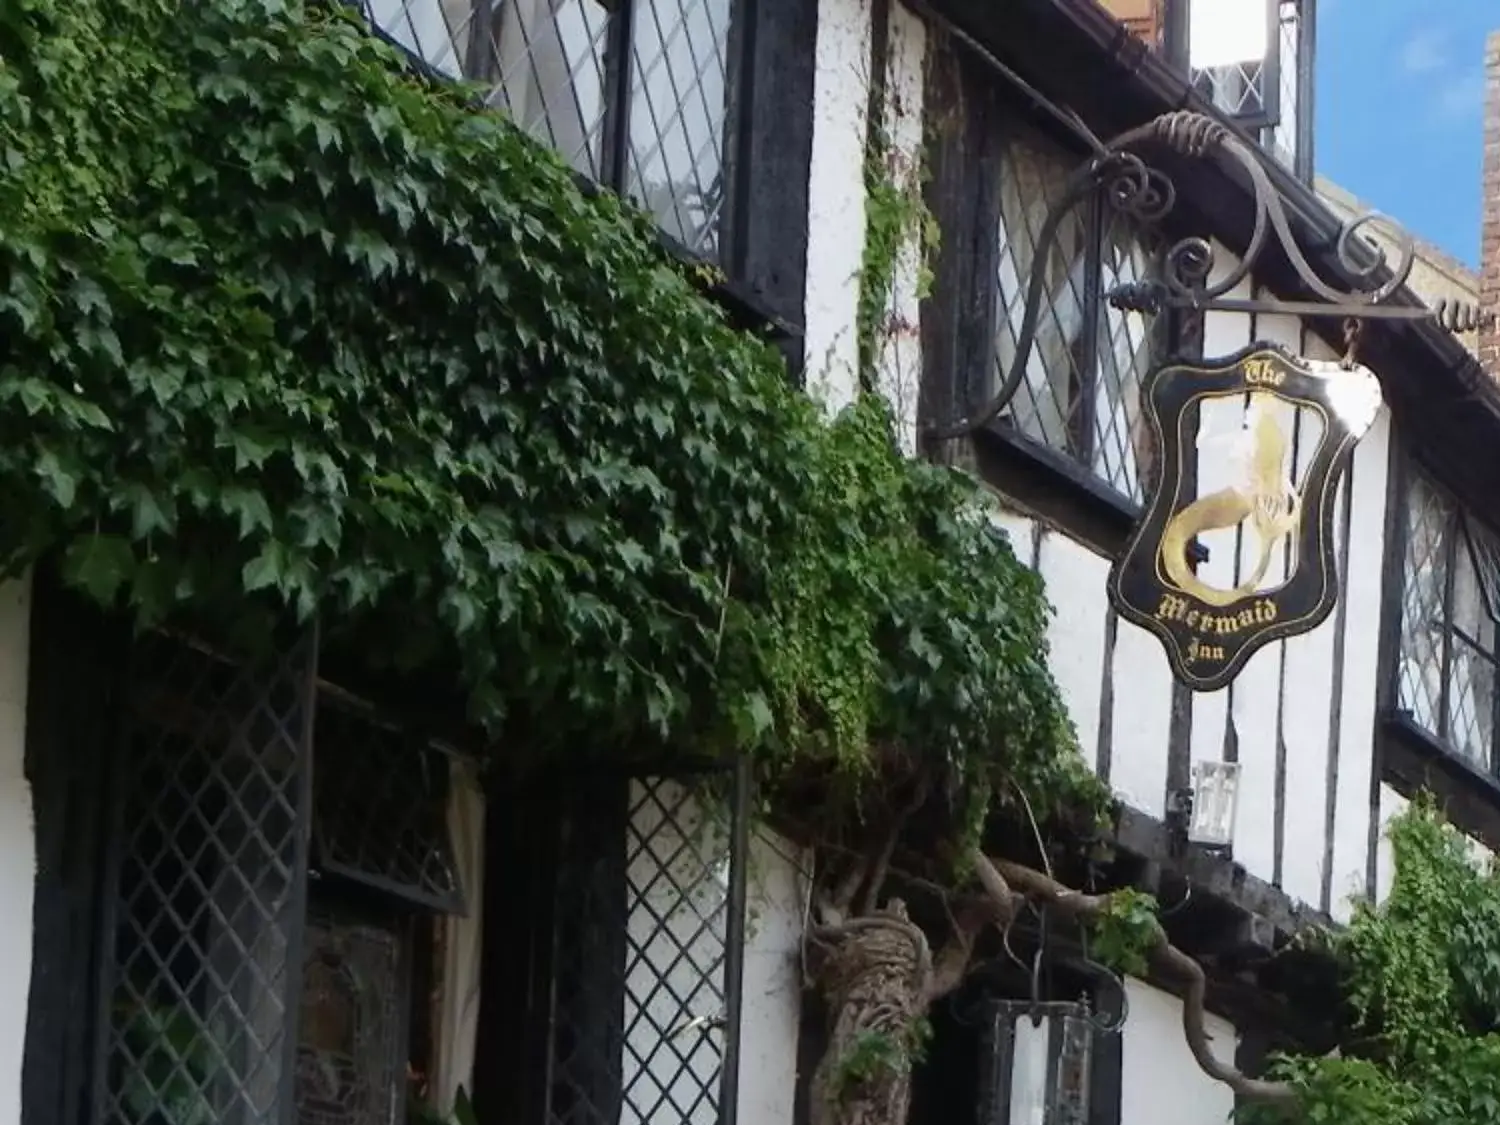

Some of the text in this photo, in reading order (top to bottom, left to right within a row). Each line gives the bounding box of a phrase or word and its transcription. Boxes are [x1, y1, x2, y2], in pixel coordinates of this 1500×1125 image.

[1244, 360, 1286, 385] The
[1155, 594, 1277, 632] Mermaid
[1184, 637, 1224, 665] Inn
